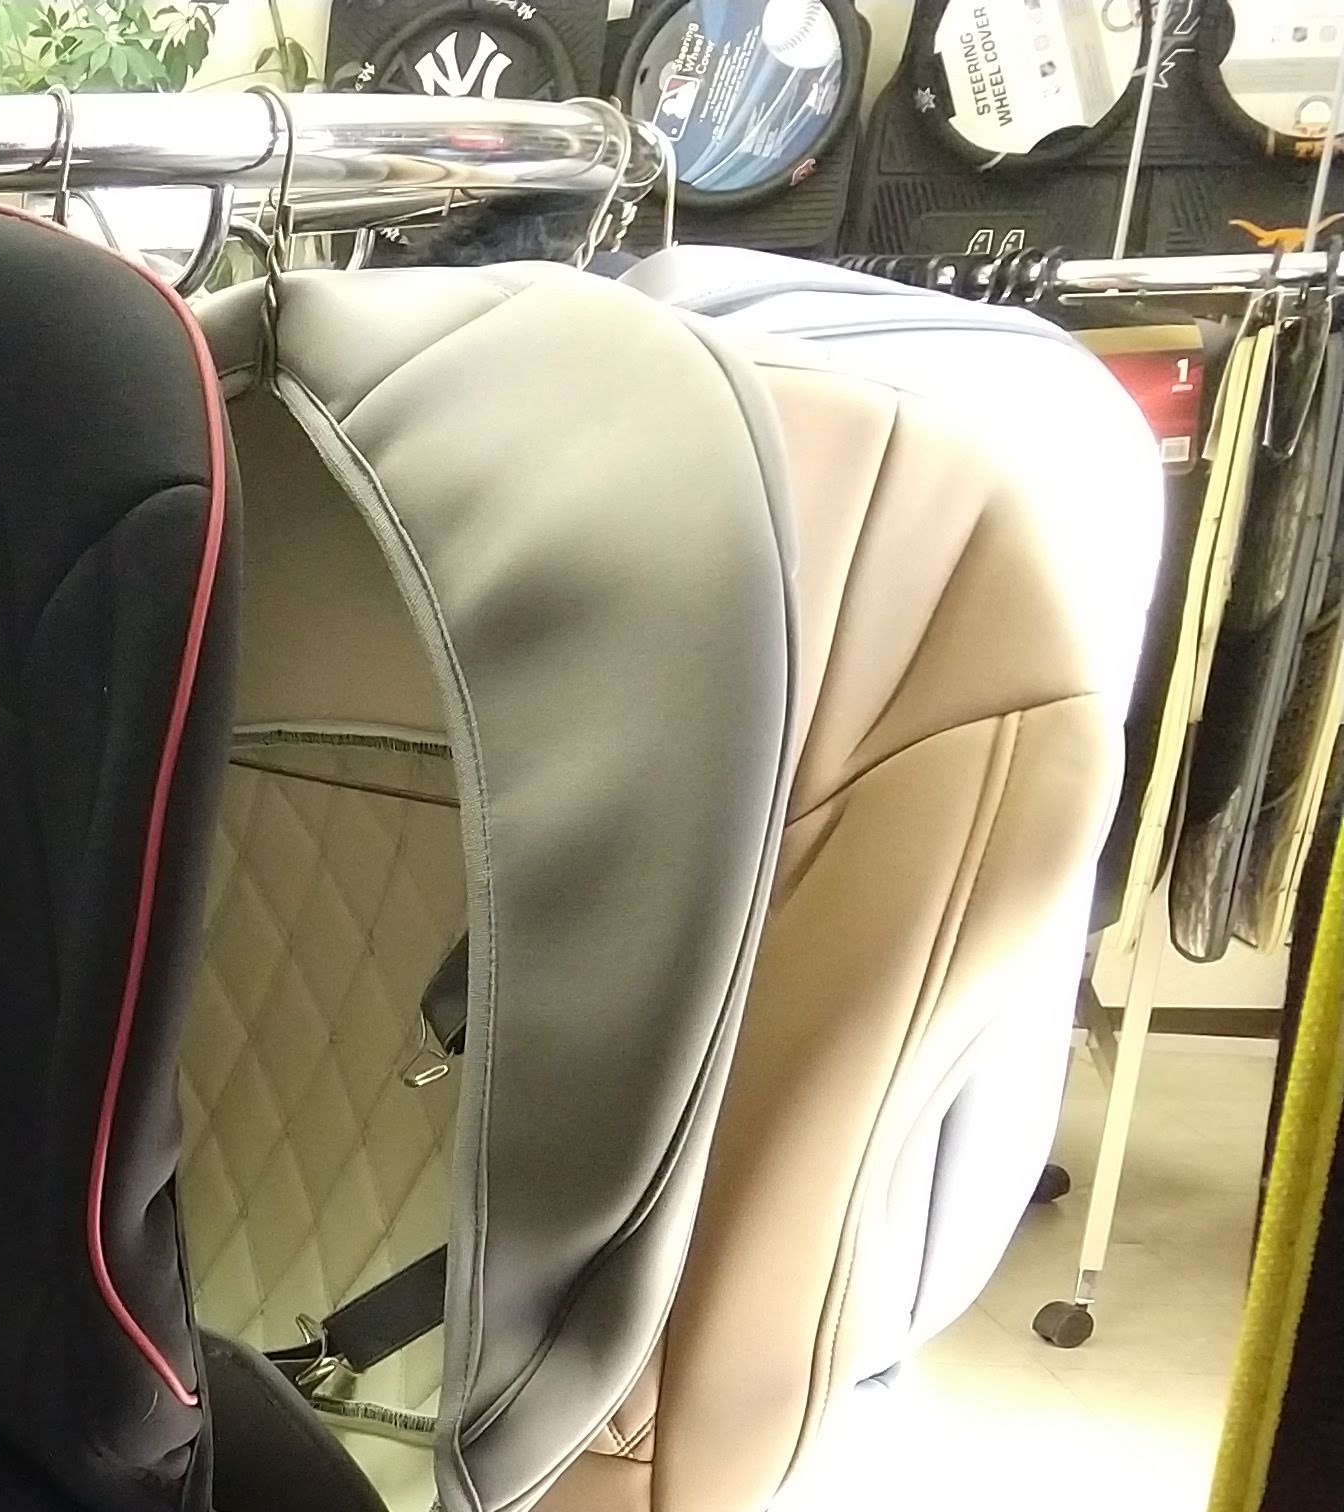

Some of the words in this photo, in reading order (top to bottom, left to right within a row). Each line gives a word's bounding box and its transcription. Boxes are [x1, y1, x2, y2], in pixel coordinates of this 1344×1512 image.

[672, 23, 699, 72] Steering
[683, 34, 704, 72] Wheel
[695, 40, 715, 74] Cover
[973, 6, 998, 63] COVER
[960, 32, 991, 116] STEERING
[988, 64, 1013, 127] WHEEL
[1176, 357, 1189, 383] 1
